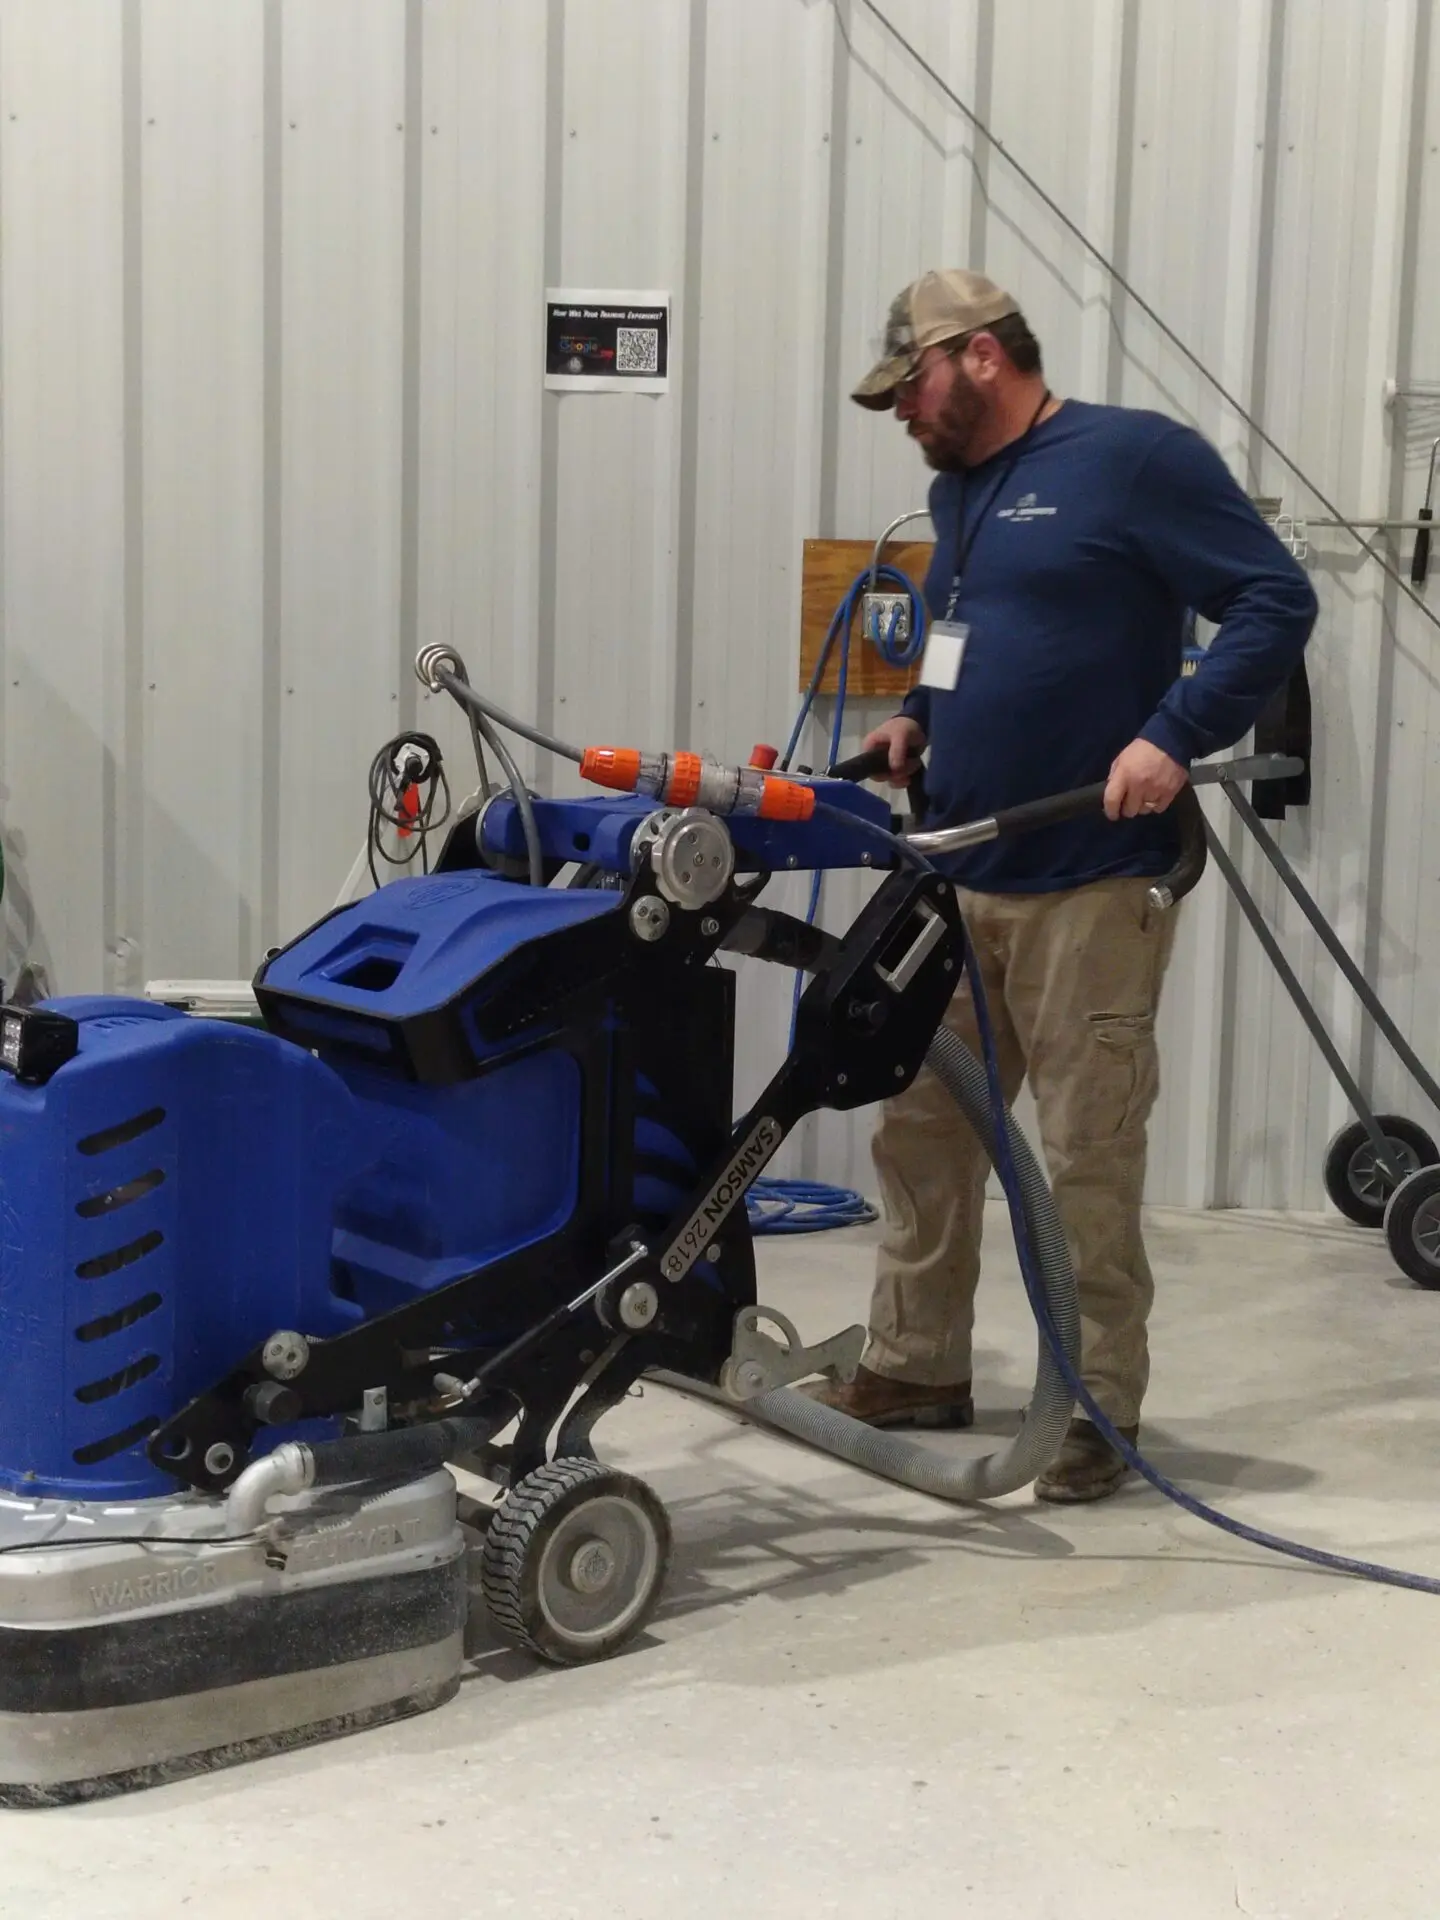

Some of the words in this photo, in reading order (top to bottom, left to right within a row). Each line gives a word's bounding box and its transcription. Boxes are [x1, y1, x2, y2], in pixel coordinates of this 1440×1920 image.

[703, 1126, 774, 1223] SAMSON
[667, 1219, 708, 1273] 2618
[87, 1560, 219, 1608] WARRIOR
